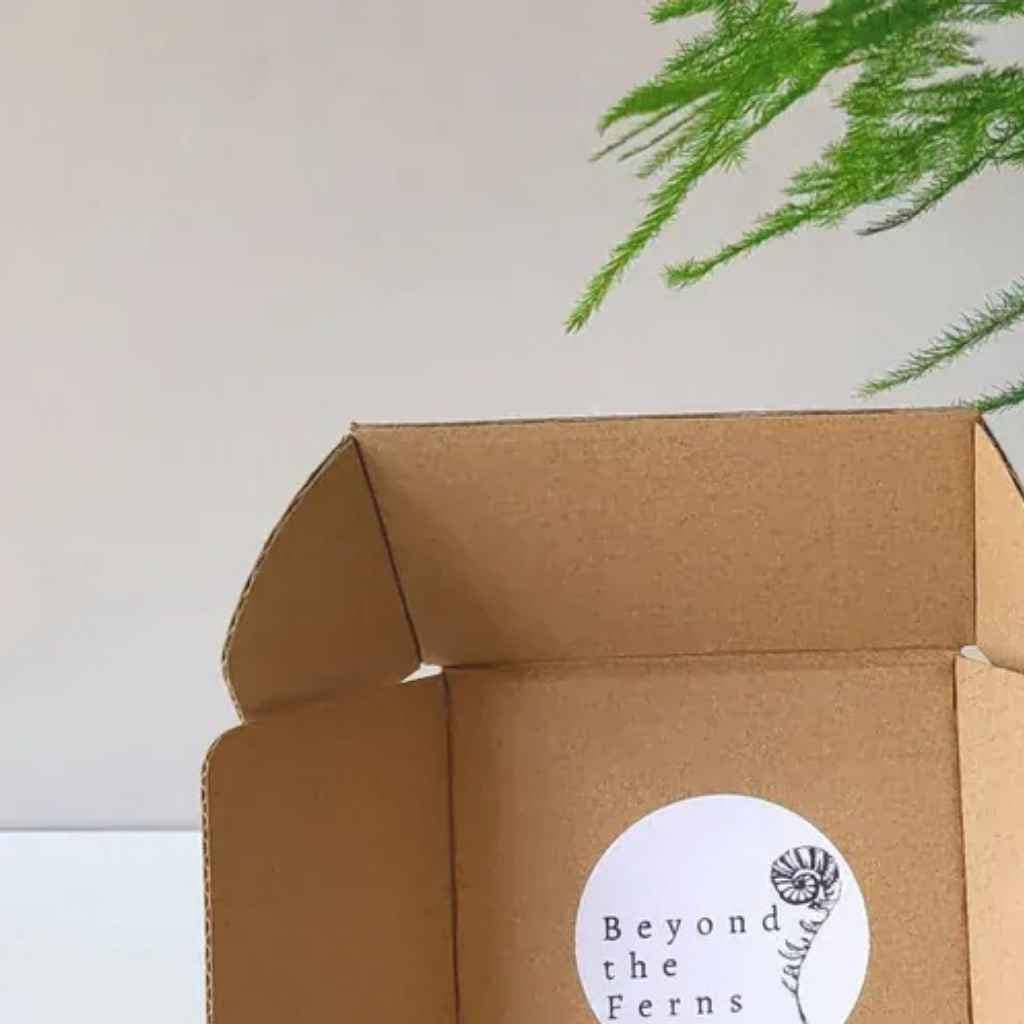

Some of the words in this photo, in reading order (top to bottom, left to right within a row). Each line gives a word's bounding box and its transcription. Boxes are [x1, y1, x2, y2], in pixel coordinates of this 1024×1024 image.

[602, 905, 781, 944] Beyond
[602, 951, 678, 980] the
[607, 993, 743, 1019] Ferns
